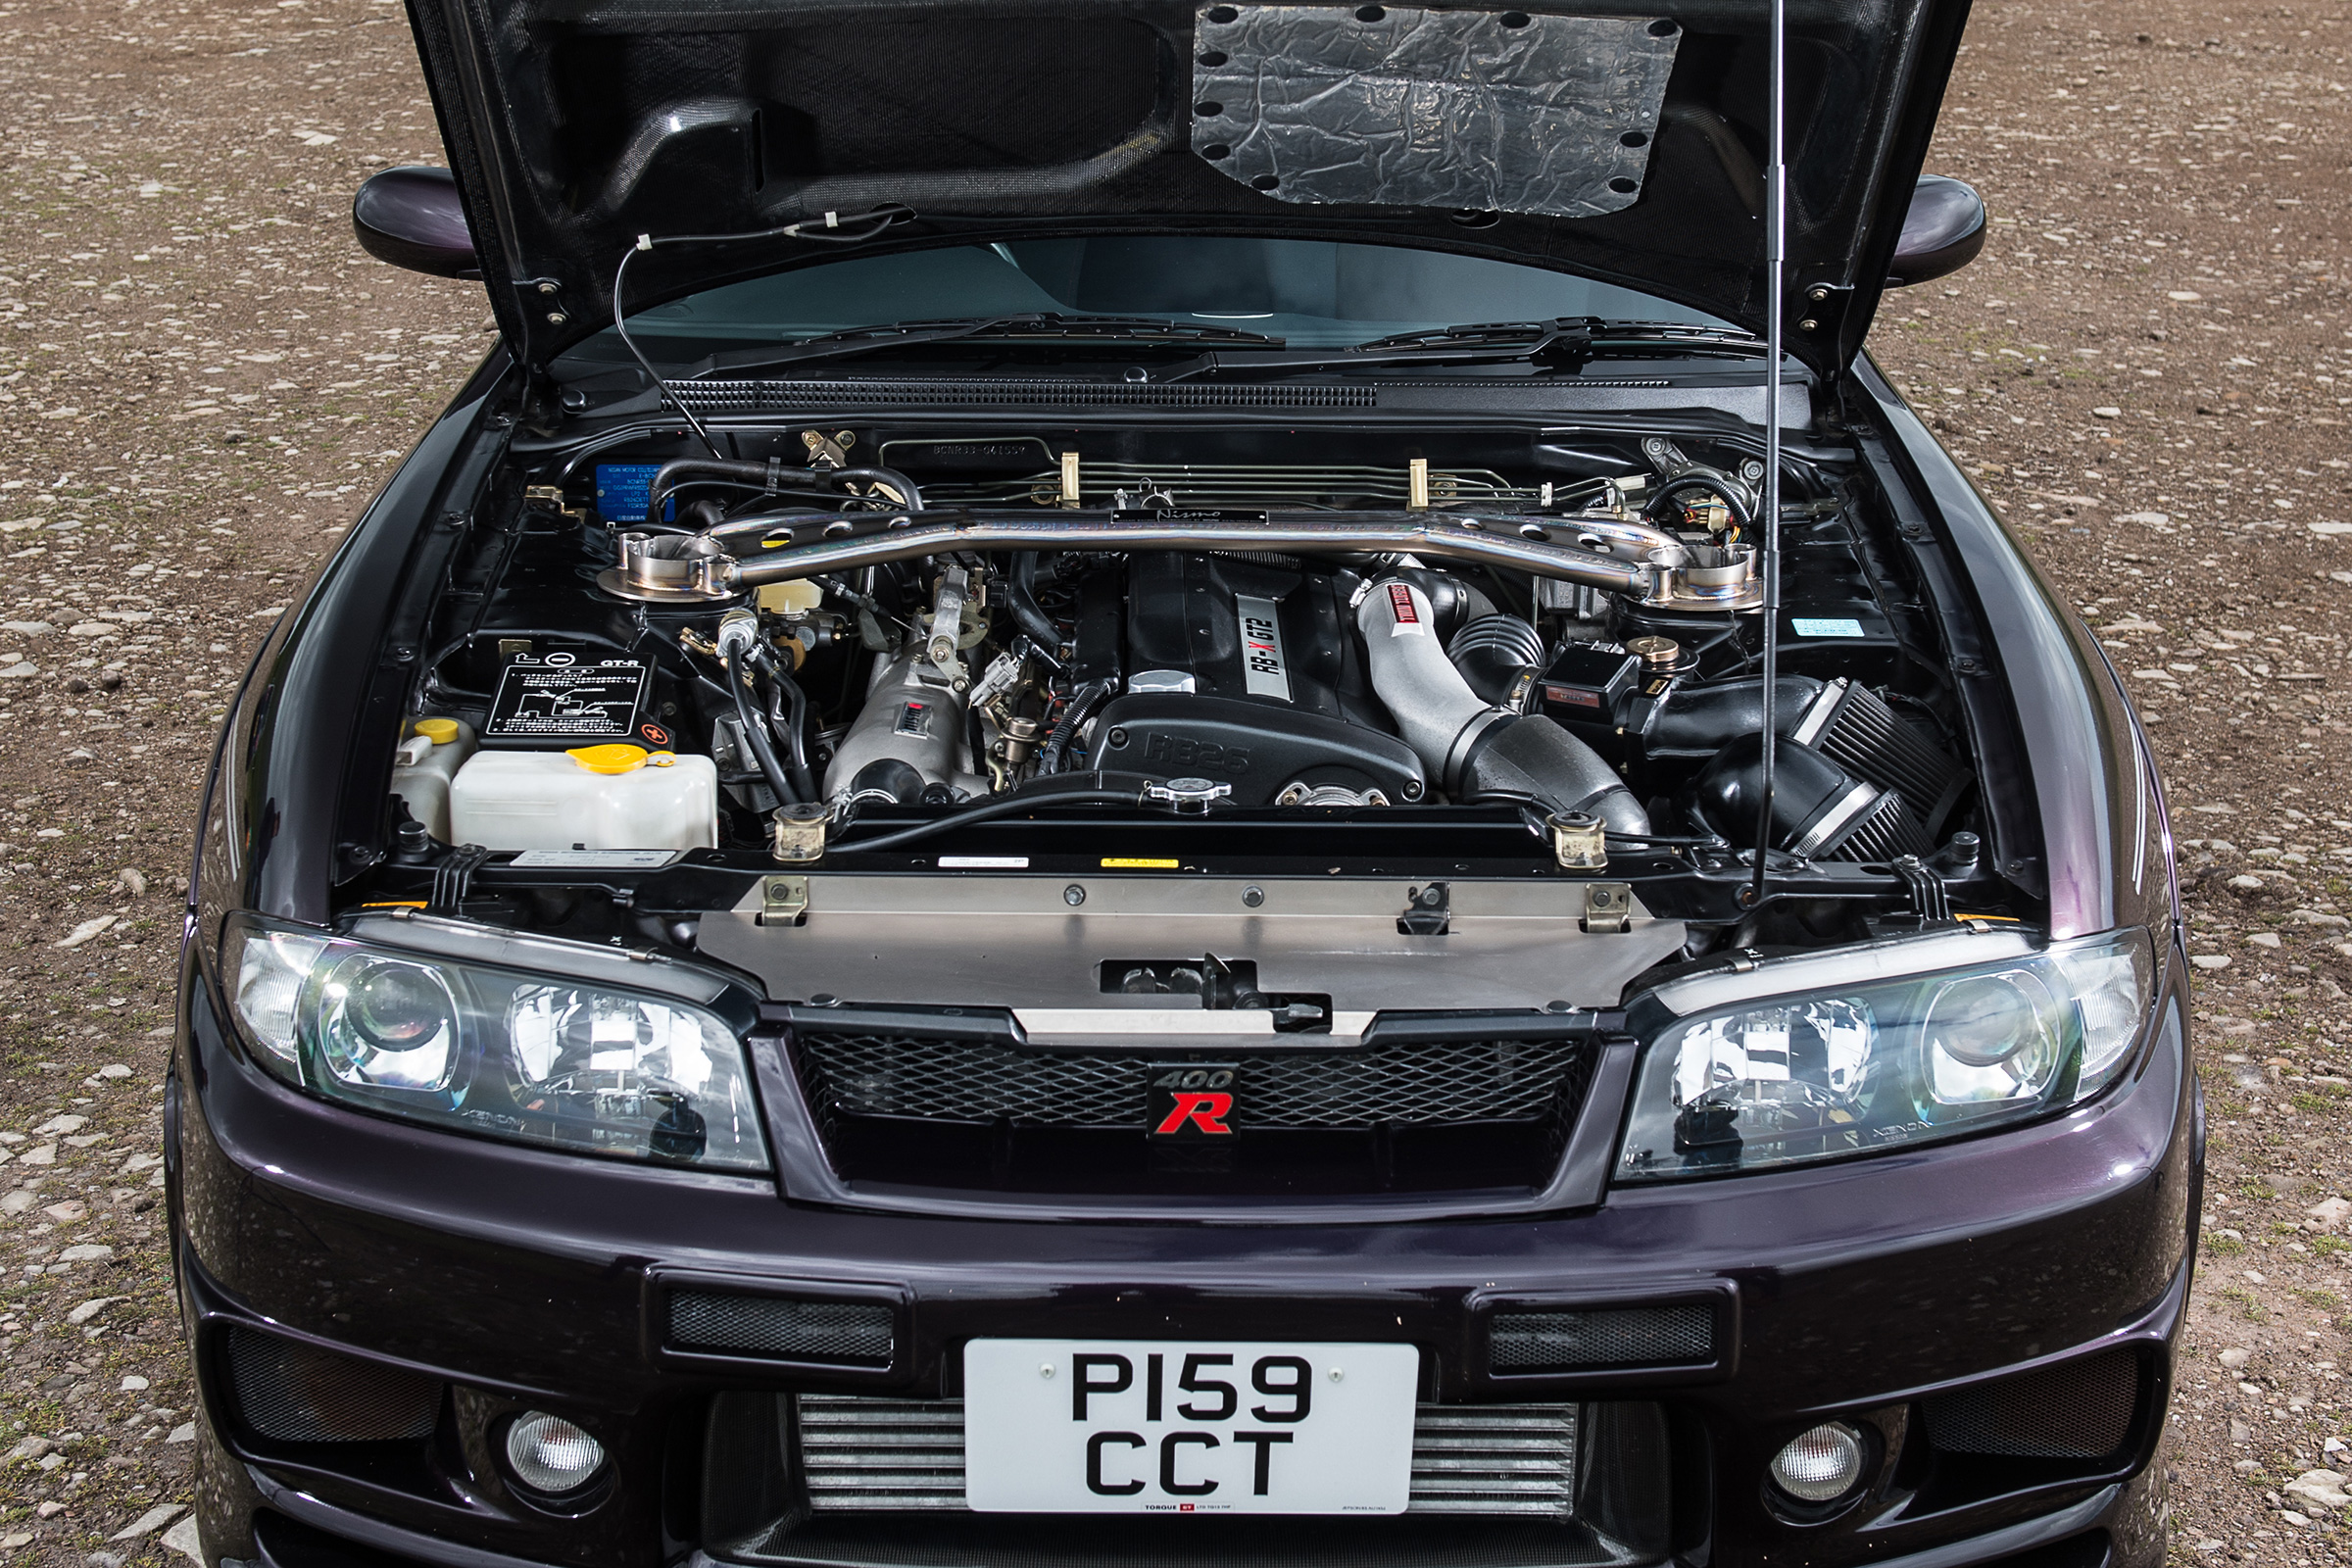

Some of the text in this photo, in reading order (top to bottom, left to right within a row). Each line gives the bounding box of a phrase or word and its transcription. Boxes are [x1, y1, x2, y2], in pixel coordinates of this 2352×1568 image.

[1245, 617, 1274, 641] GT2
[1144, 731, 1251, 774] RB26
[1152, 1070, 1235, 1089] 400
[1153, 1092, 1234, 1135] R
[1072, 1352, 1312, 1423] P159
[1086, 1431, 1295, 1495] CCT
